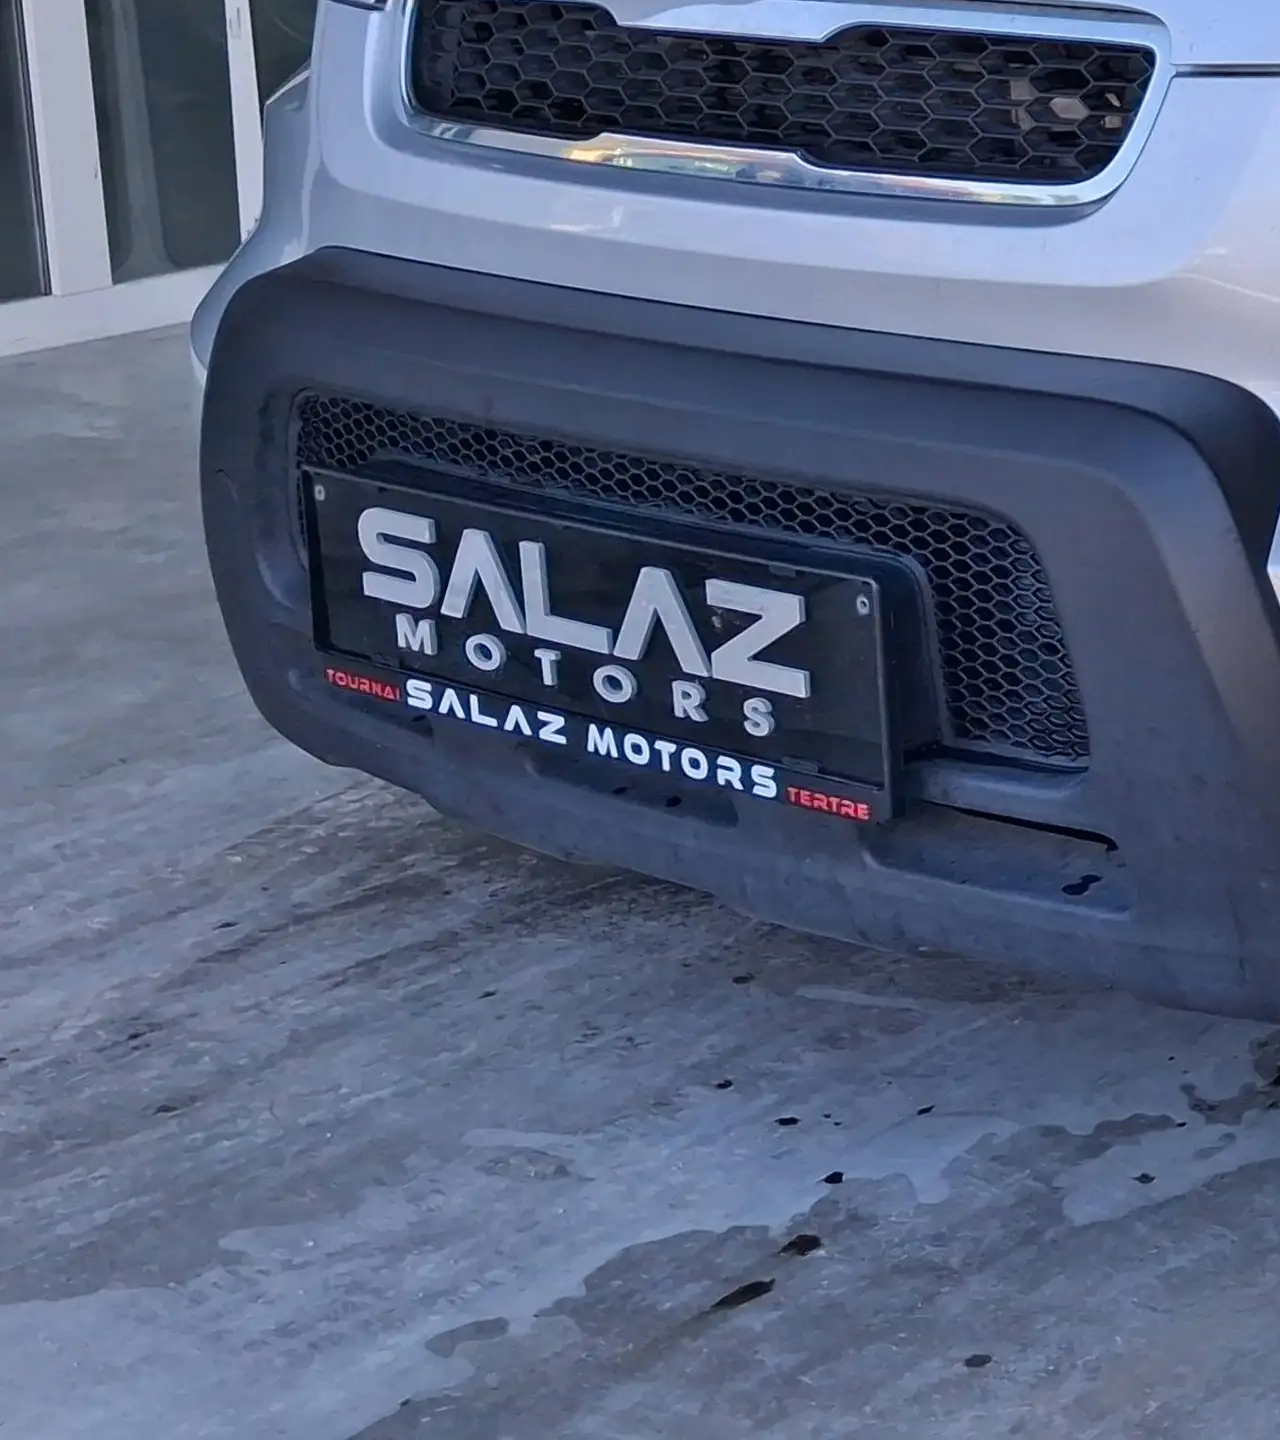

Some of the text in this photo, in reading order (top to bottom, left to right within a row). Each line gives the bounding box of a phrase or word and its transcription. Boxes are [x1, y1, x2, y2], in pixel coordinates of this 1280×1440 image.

[358, 507, 811, 698] SALAZ
[395, 613, 776, 737] MOTORS
[325, 668, 871, 821] TOURNAI SALAZ MOTORS TERTRE
